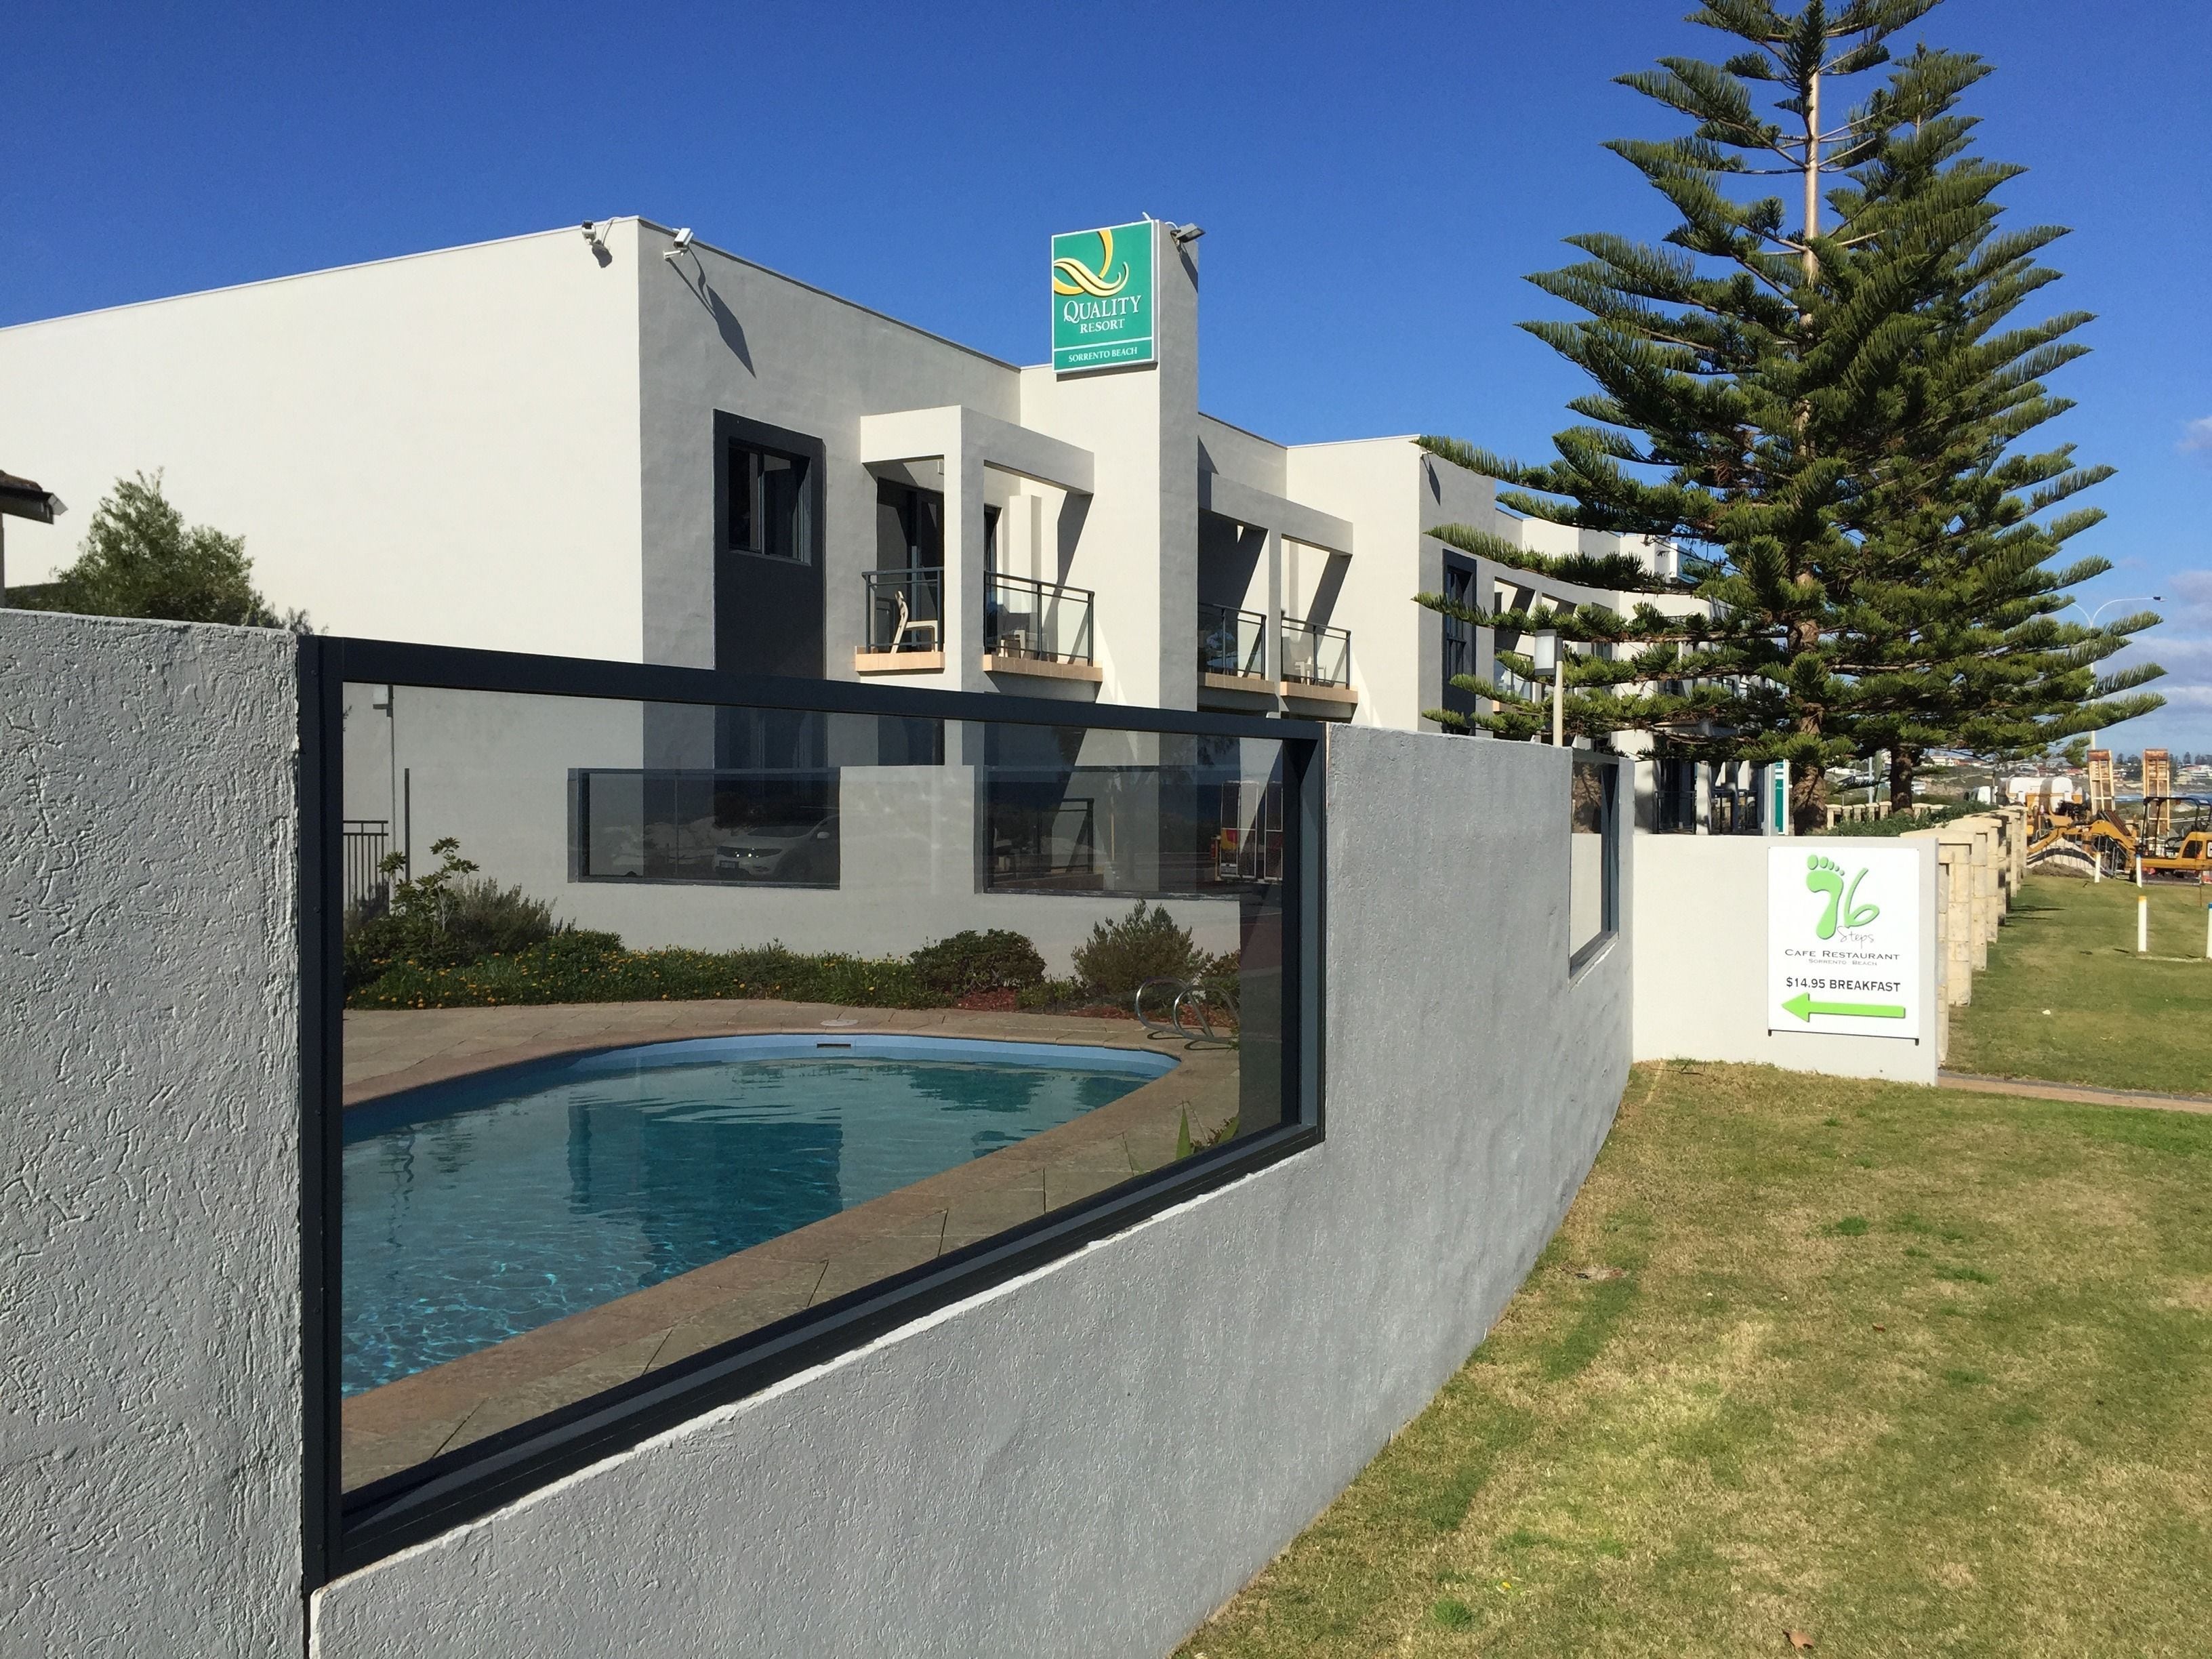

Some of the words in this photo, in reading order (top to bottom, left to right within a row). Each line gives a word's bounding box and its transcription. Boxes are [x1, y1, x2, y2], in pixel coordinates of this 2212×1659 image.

[1063, 295, 1141, 323] QUALITY
[1080, 319, 1125, 333] RESORT
[1069, 350, 1110, 363] SORRENTO
[1111, 346, 1137, 358] BEACH
[1837, 926, 1875, 949] Steps
[1786, 976, 1826, 989] $14.95
[1830, 979, 1901, 992] BREAKFAST
